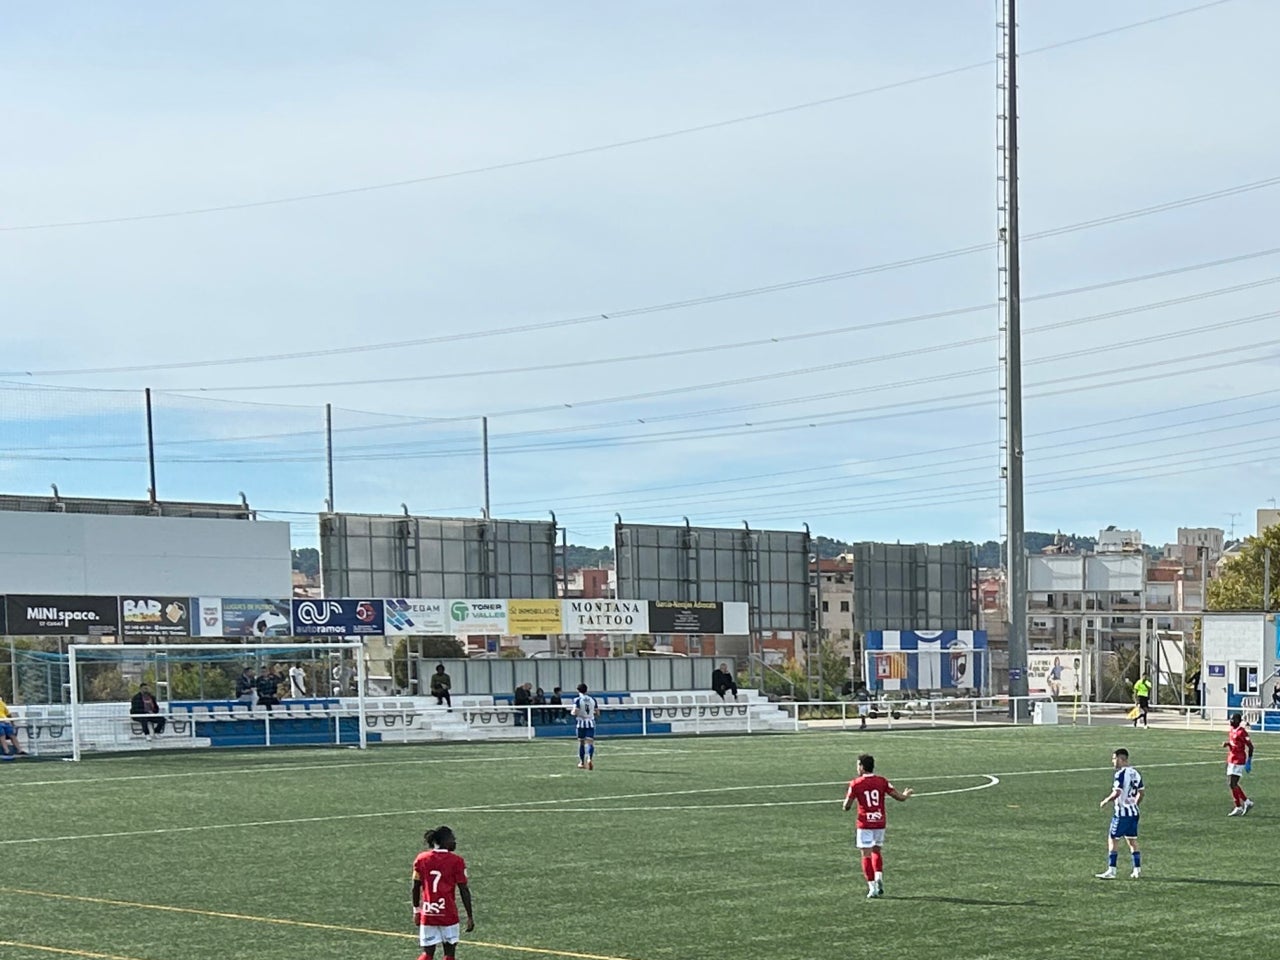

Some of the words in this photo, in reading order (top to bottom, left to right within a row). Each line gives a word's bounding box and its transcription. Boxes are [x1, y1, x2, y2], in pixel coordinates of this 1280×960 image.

[571, 602, 640, 613] MONTANA
[578, 615, 633, 625] TATTOO
[296, 625, 346, 633] autoramos
[864, 789, 879, 807] 19
[430, 870, 441, 893] 7
